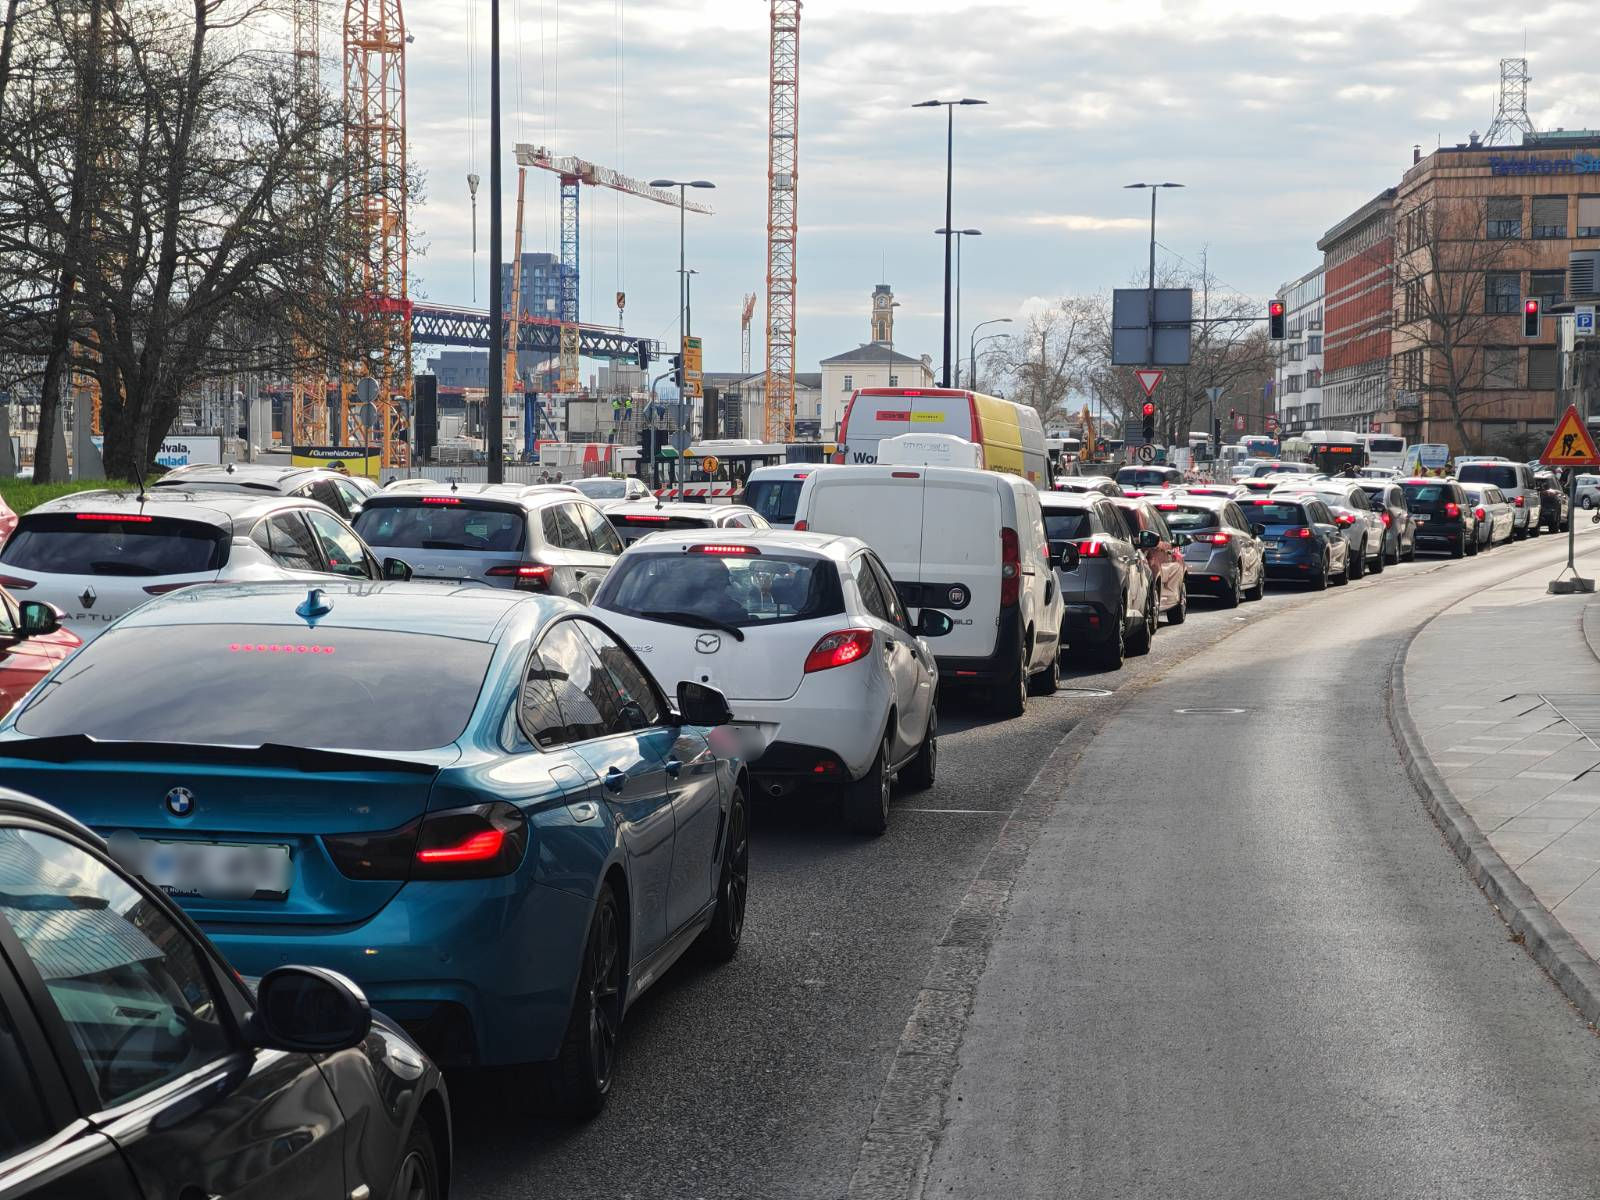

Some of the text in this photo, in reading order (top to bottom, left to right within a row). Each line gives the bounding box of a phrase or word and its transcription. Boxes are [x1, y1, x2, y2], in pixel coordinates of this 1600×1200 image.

[1581, 317, 1590, 327] P
[159, 442, 191, 455] Hvala,
[157, 455, 188, 466] mladi
